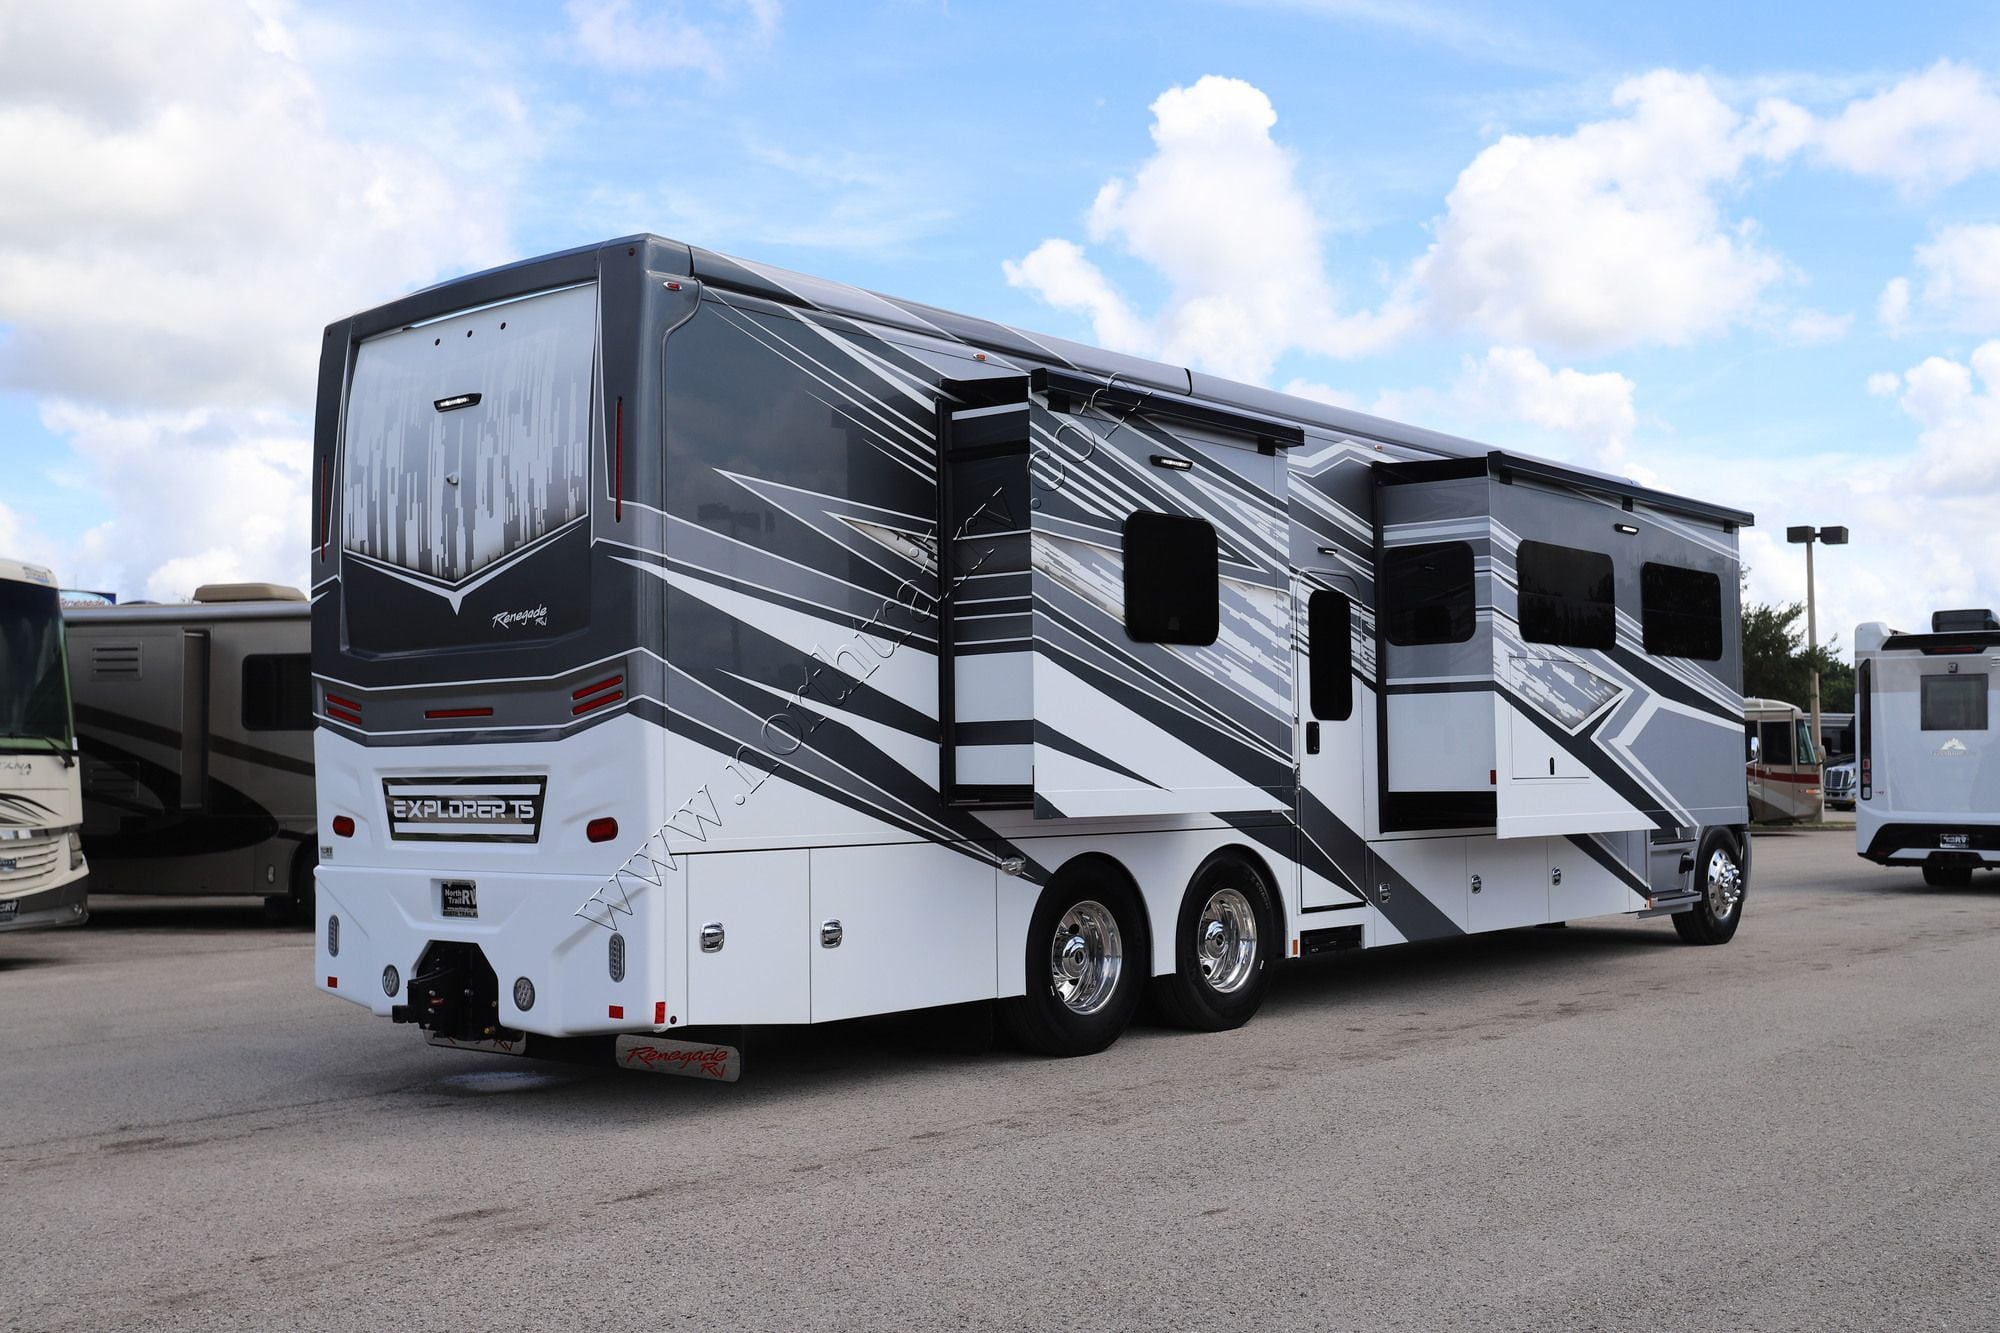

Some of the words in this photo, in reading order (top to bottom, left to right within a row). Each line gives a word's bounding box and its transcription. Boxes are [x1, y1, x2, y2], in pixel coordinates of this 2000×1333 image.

[492, 603, 548, 629] Renegade
[535, 616, 547, 626] RV
[393, 800, 506, 818] EXPLORER
[509, 800, 535, 818] TS
[444, 889, 462, 897] North
[447, 896, 462, 904] Trail
[626, 1046, 728, 1069] Renegade
[700, 1062, 726, 1078] RV
